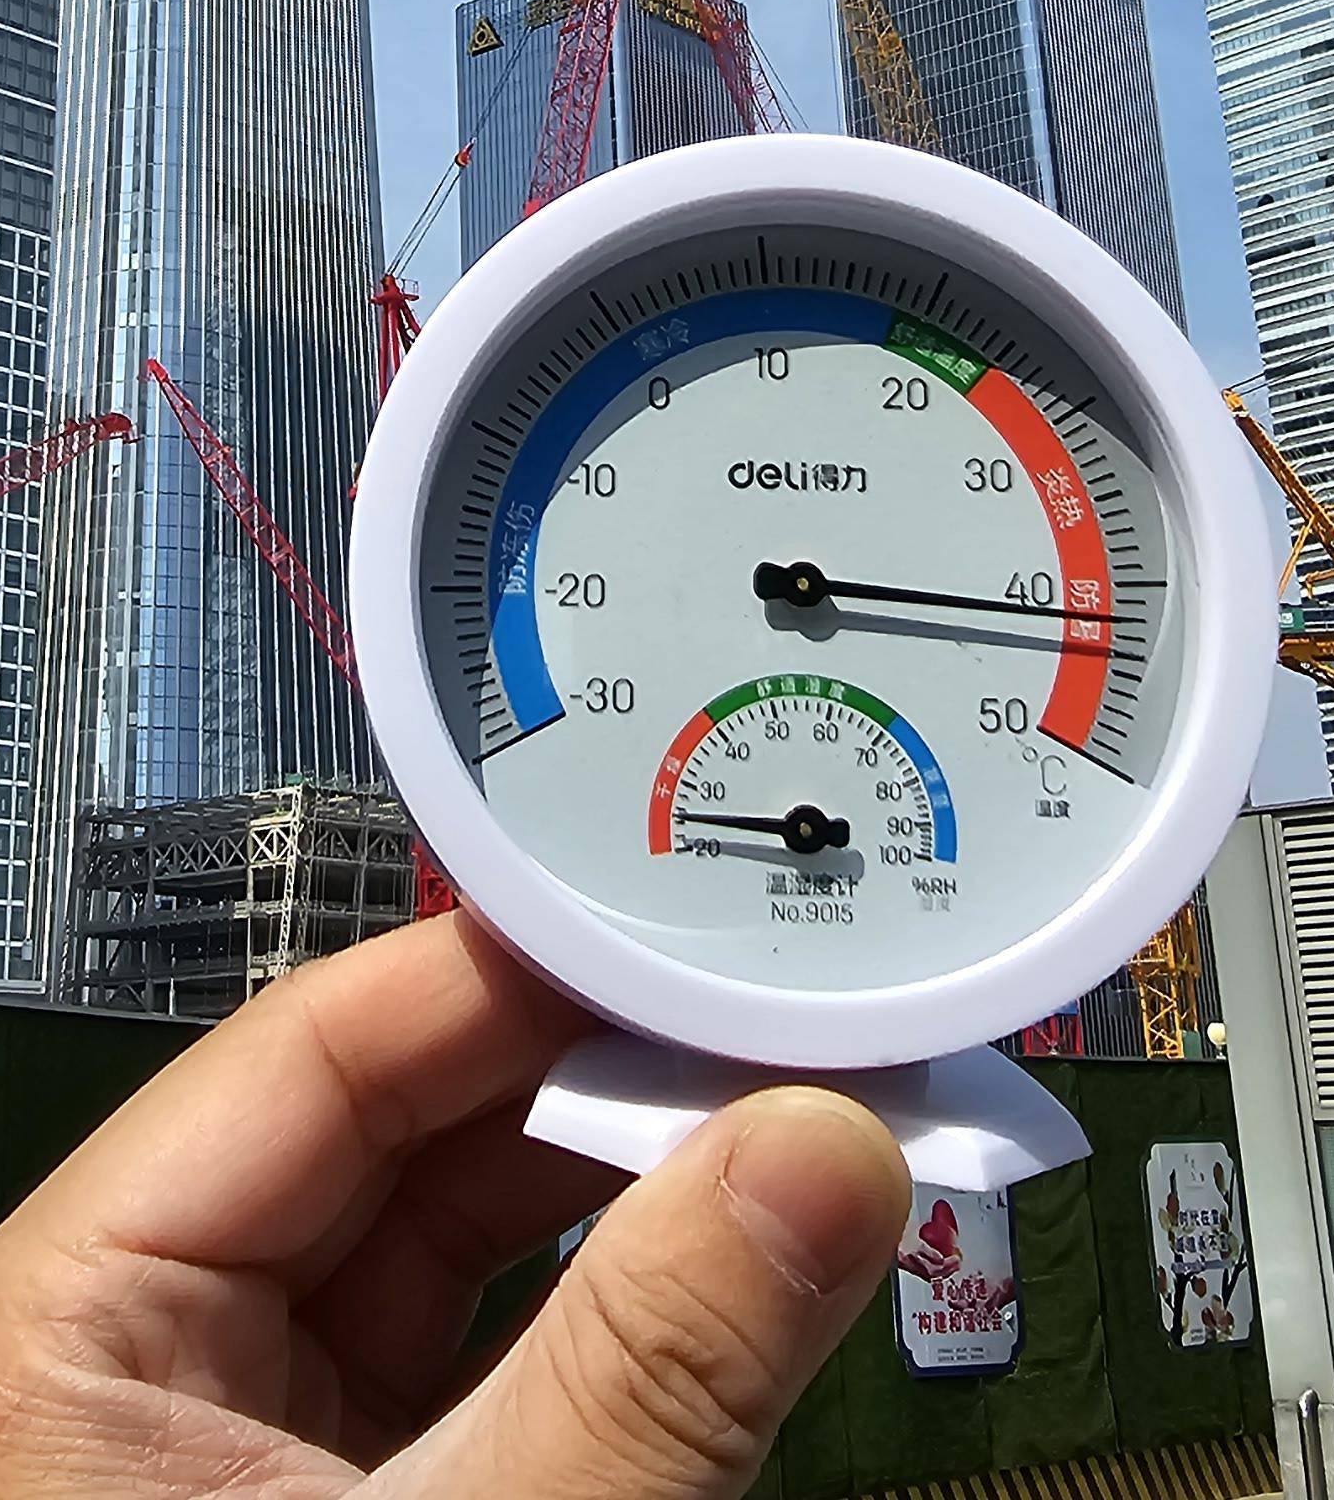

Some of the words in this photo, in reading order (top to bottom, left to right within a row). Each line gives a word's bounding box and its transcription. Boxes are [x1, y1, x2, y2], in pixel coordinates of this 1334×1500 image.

[755, 347, 790, 381] 10
[648, 376, 671, 410] 0
[881, 376, 929, 411] 20
[567, 462, 616, 498] -10
[963, 458, 1013, 493] 30
[1035, 466, 1085, 531] 炎热
[544, 572, 607, 609] -20
[1004, 571, 1054, 606] 40
[569, 676, 635, 714] -30
[978, 697, 1029, 734] 50
[764, 719, 790, 741] 50
[812, 722, 839, 744] 60
[724, 741, 751, 761] 40
[854, 747, 879, 768] 70
[699, 780, 726, 801] 30
[875, 781, 902, 802] 80
[886, 816, 913, 836] 90
[693, 837, 722, 858] 20
[878, 844, 912, 866] 100
[910, 876, 957, 896] %RH
[770, 900, 854, 925] No.9015
